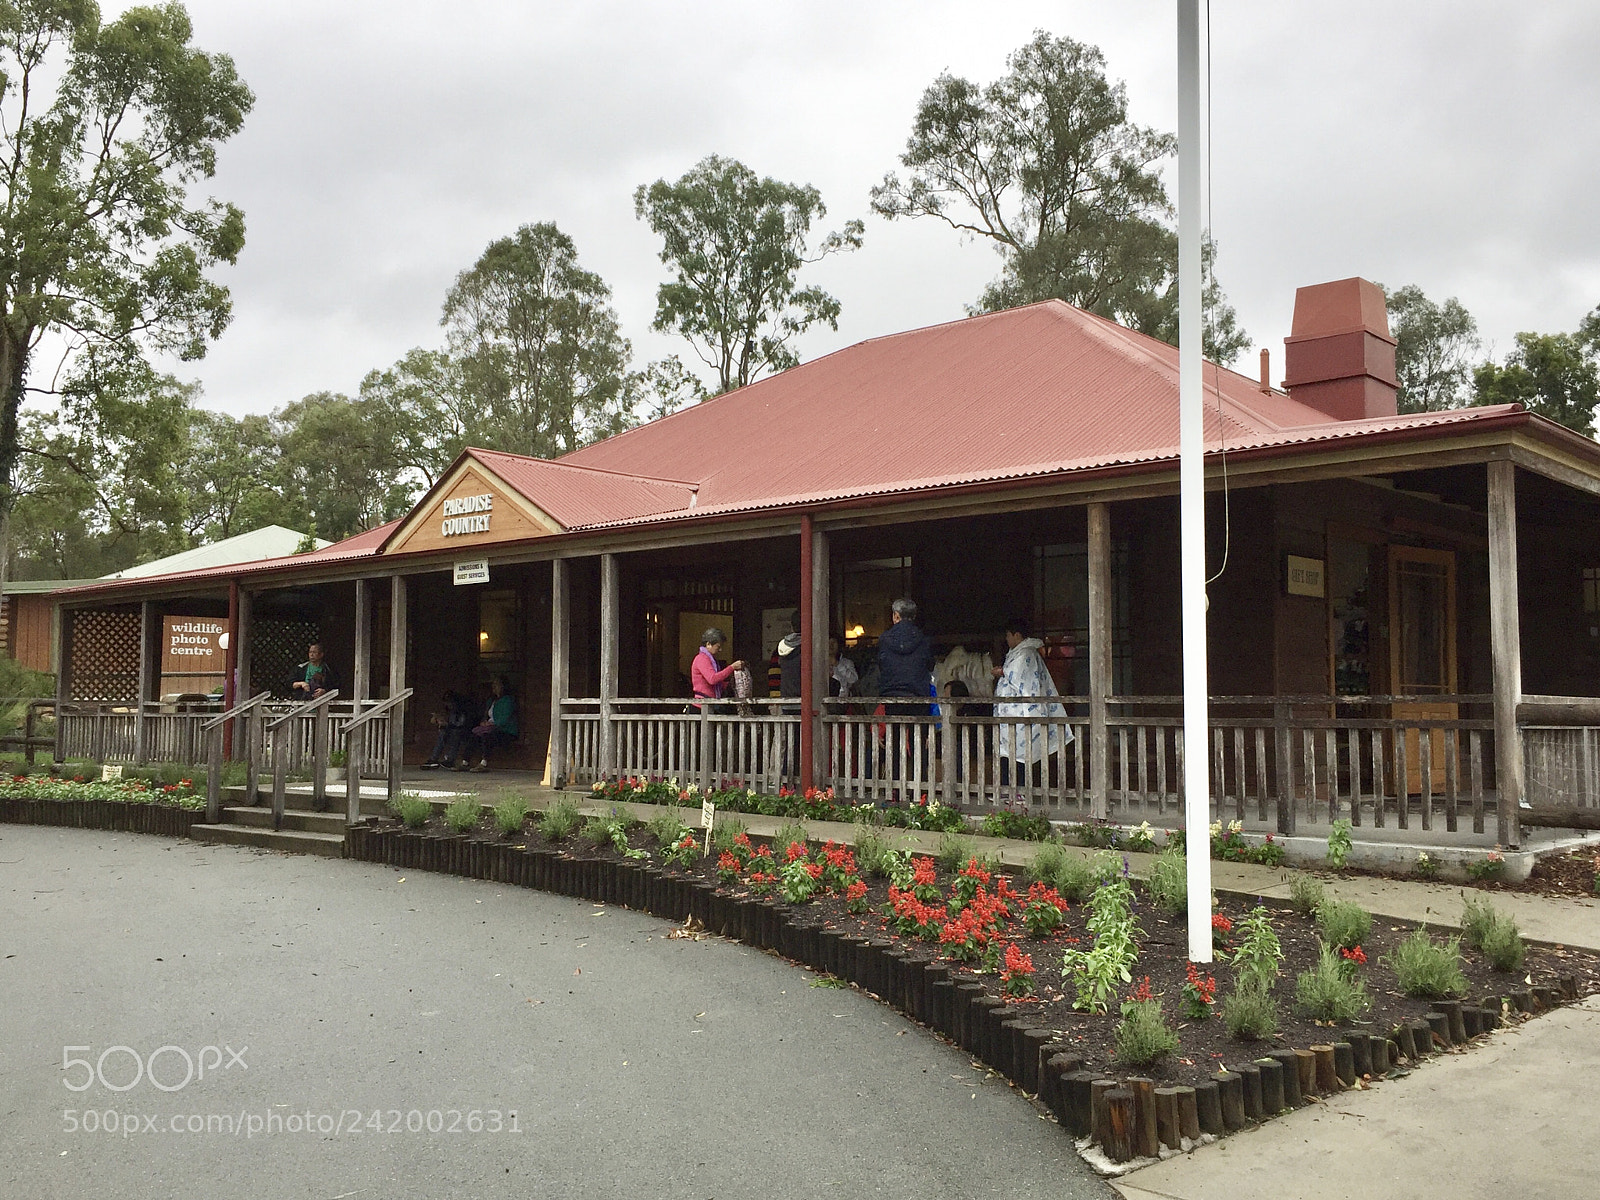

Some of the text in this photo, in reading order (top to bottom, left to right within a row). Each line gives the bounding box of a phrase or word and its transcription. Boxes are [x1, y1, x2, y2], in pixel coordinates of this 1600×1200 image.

[443, 493, 493, 517] PARADISE
[442, 514, 491, 536] COUNTRY
[171, 622, 223, 633] wildlife
[171, 633, 209, 646] photo
[171, 646, 213, 656] centre
